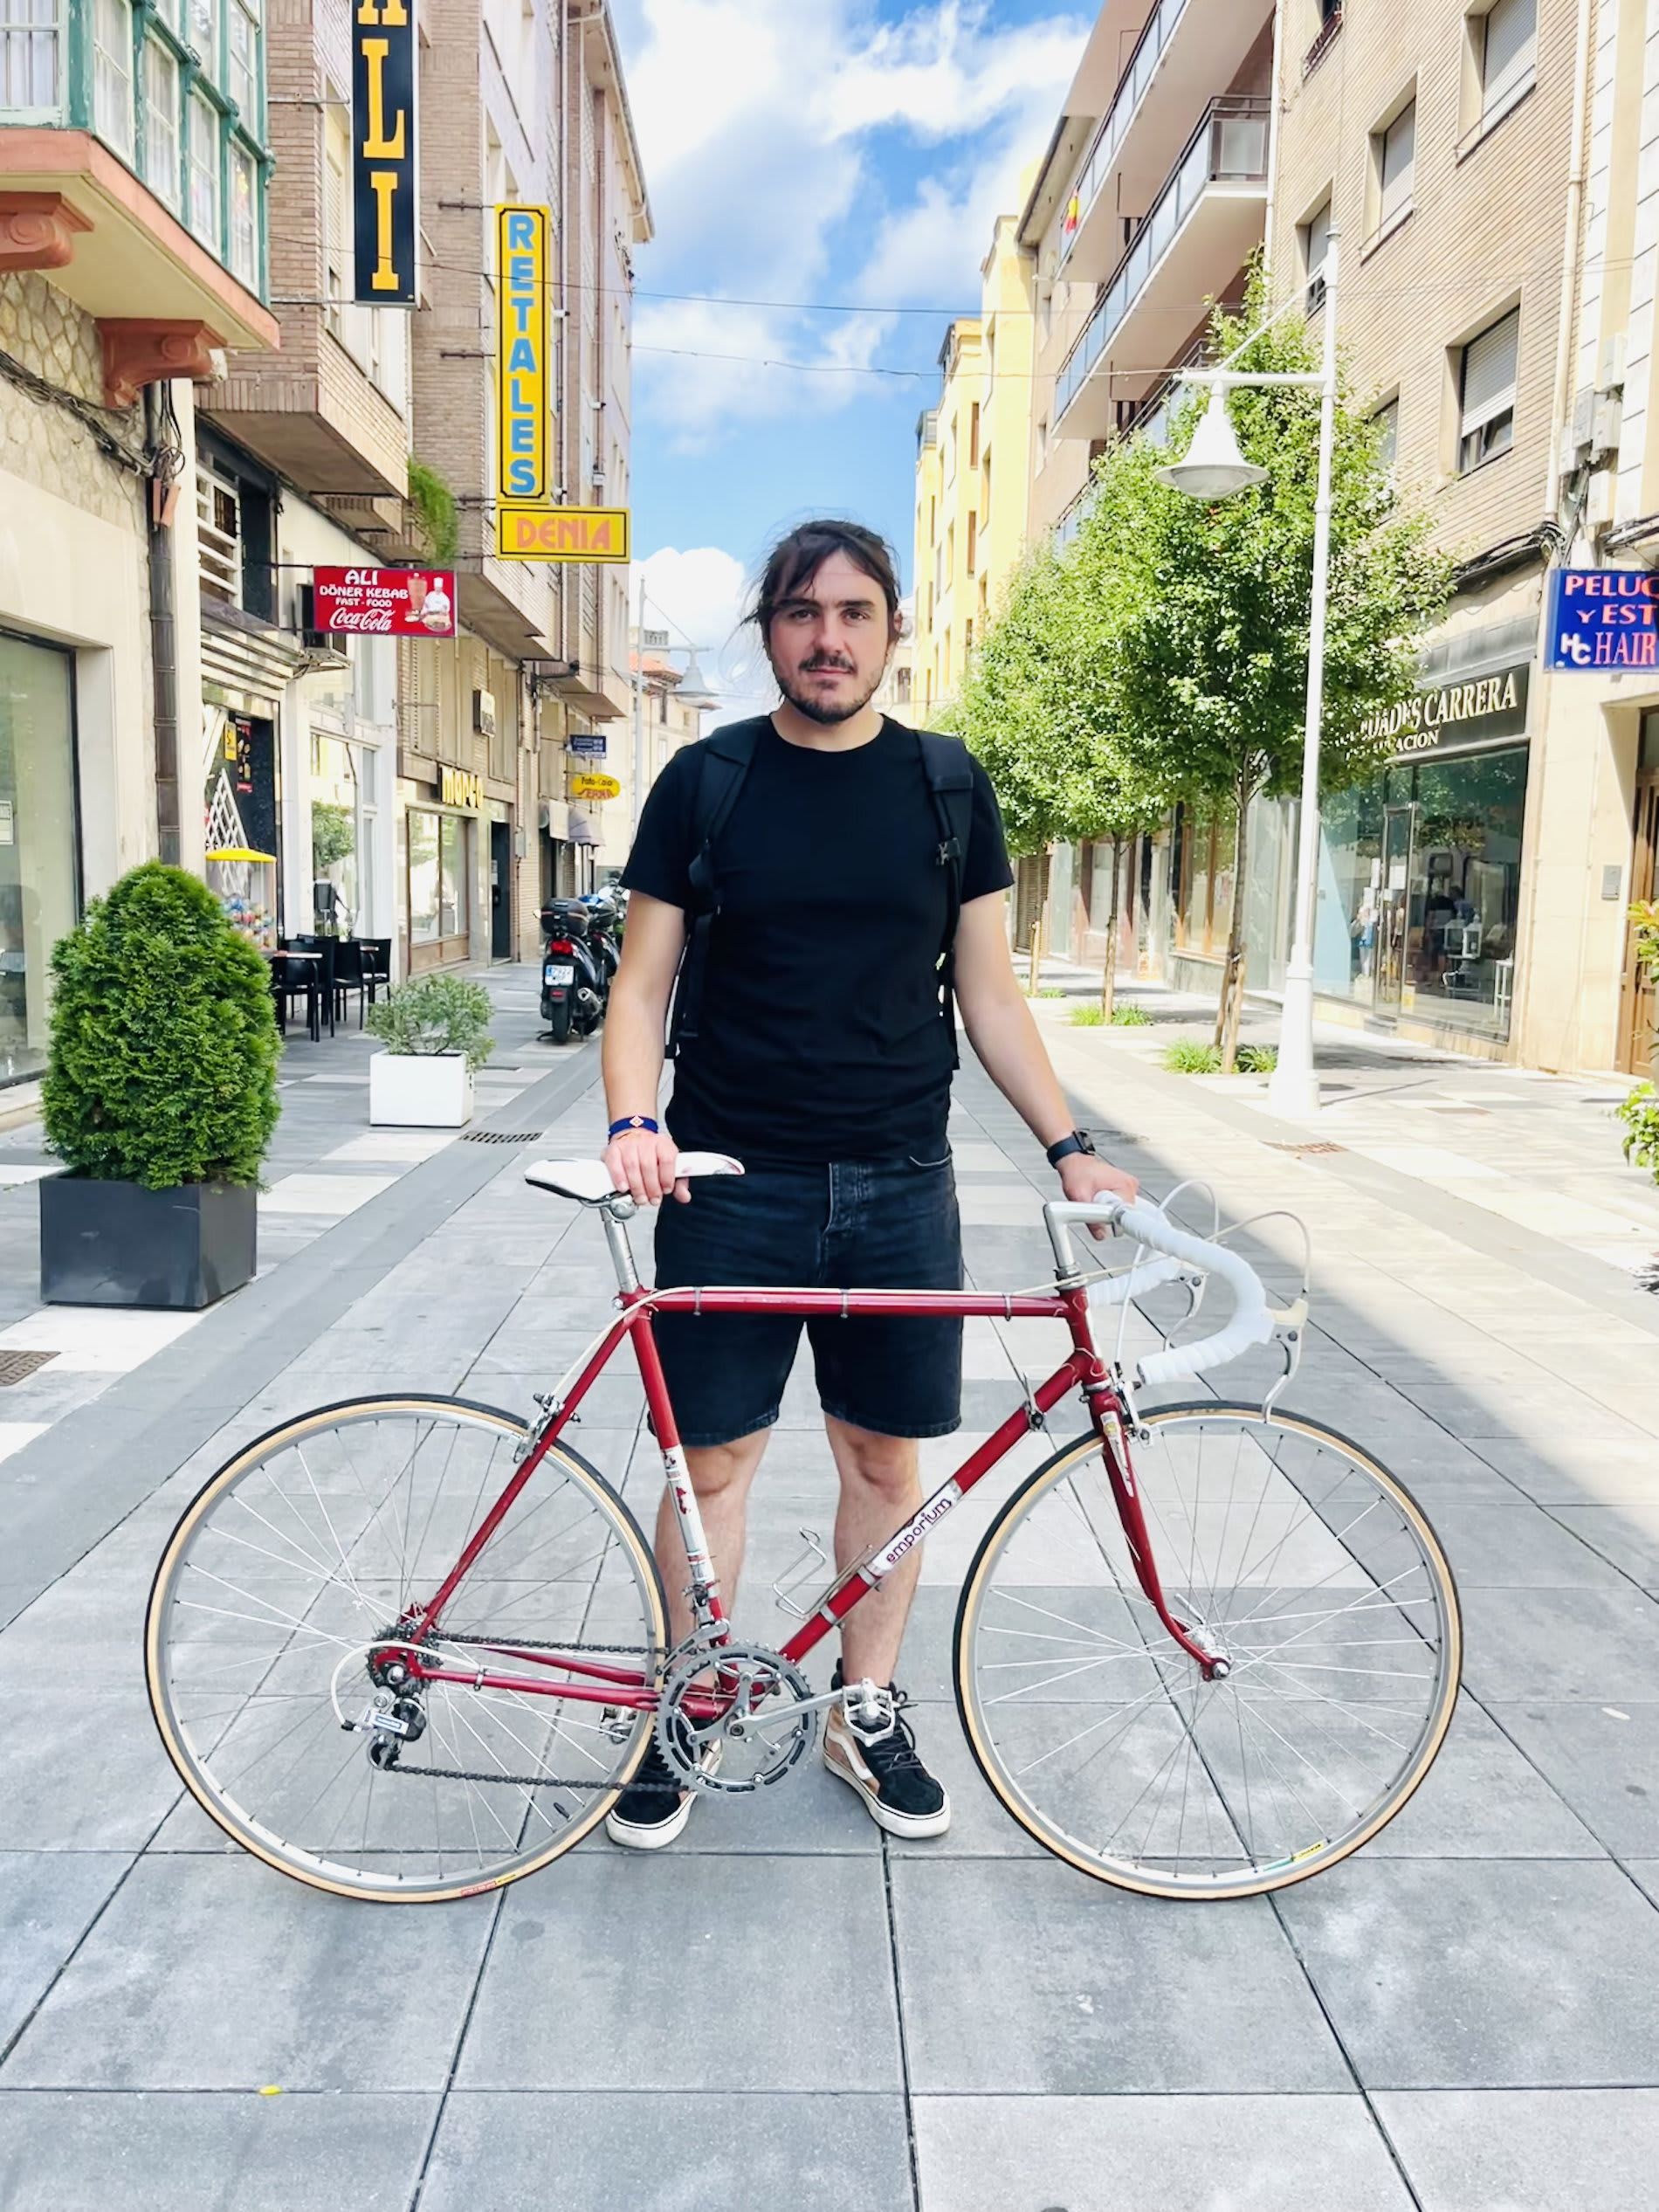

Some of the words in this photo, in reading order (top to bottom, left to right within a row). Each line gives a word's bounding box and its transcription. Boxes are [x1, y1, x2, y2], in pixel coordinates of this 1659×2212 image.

[358, 0, 407, 290] LI
[509, 215, 536, 493] RETALES
[517, 517, 610, 550] DENIA
[320, 583, 363, 597] DÖNER
[366, 587, 409, 599] KEBAB
[345, 569, 378, 585] ALI
[329, 606, 396, 631] Coca-Cola
[335, 597, 360, 606] FAST
[366, 598, 393, 608] FOOD
[1576, 610, 1596, 624] Y
[1601, 603, 1657, 625] EST
[1593, 631, 1656, 665] HAIR
[1424, 672, 1518, 727] CARRERA
[885, 1498, 952, 1565] emporium
